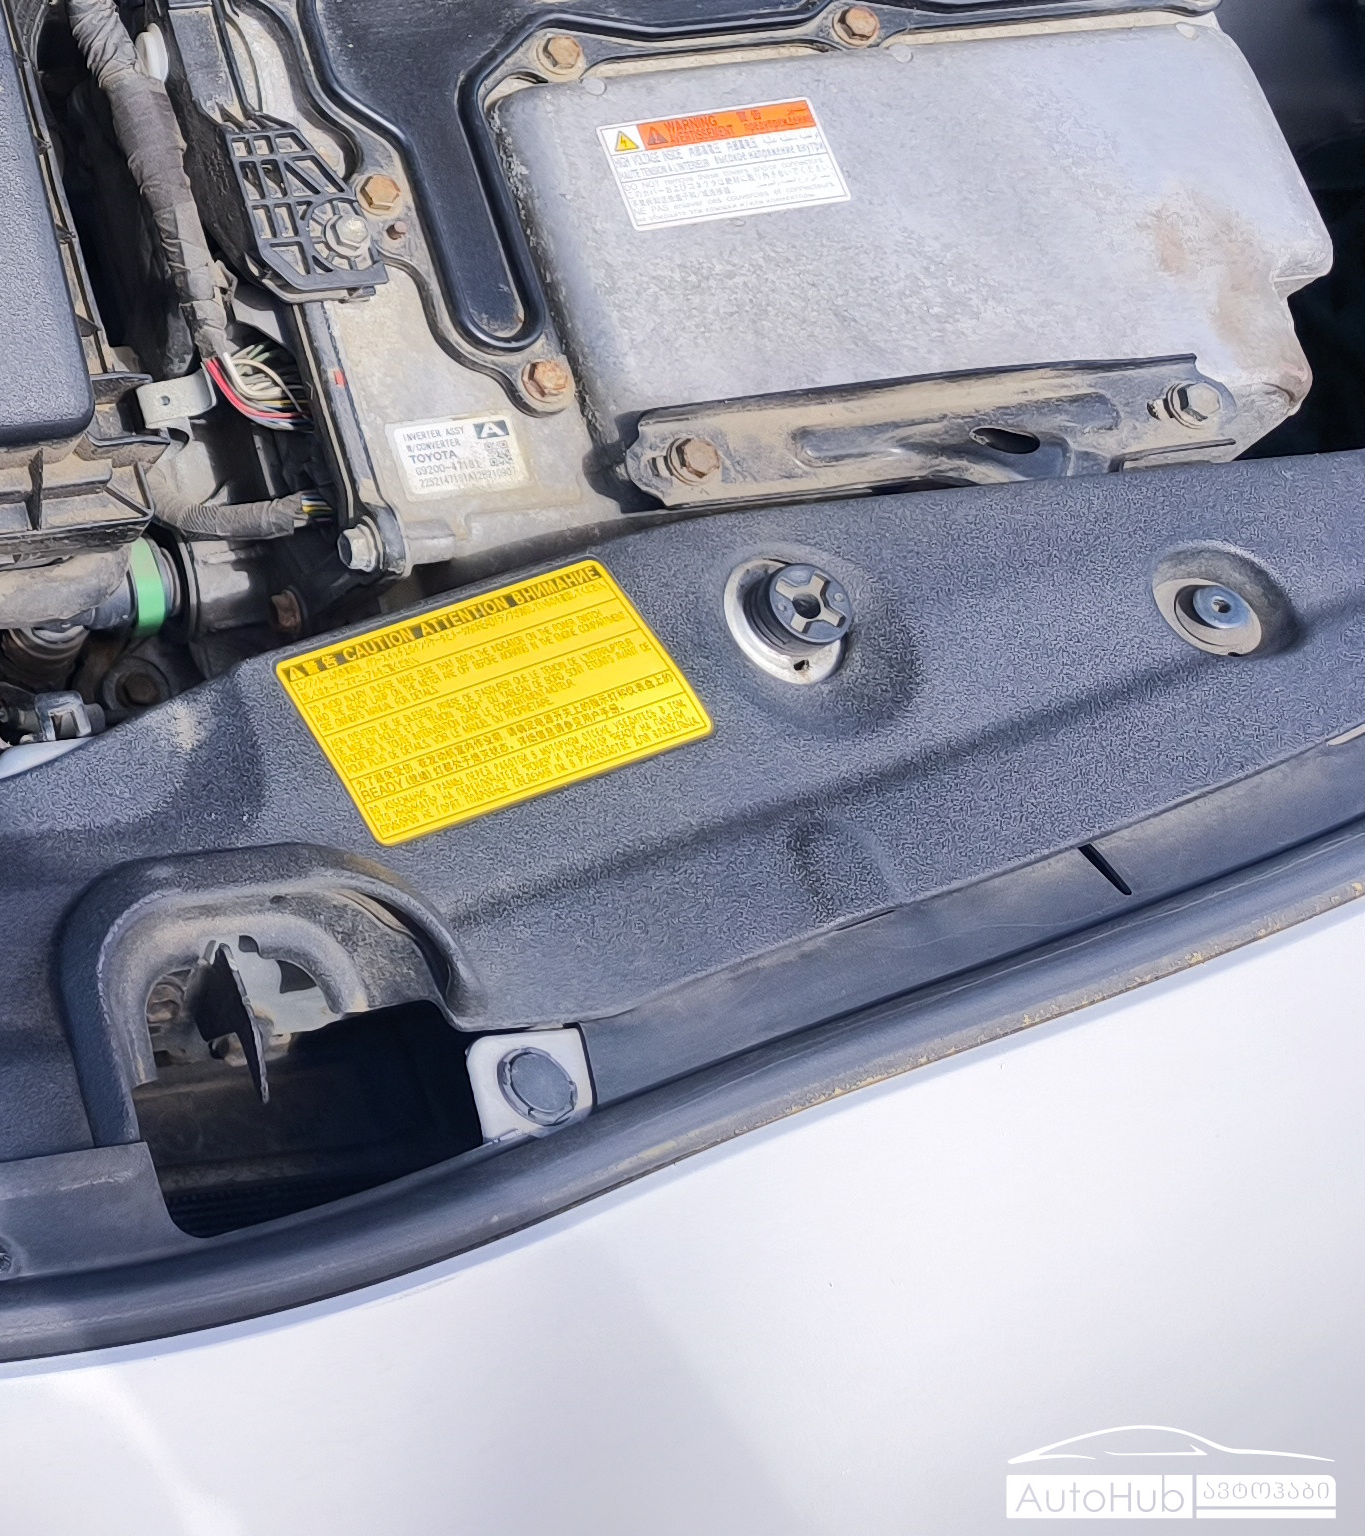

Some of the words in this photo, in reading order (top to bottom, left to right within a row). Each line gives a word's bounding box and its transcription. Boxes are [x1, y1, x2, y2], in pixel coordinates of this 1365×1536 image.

[663, 114, 718, 133] WARNING
[408, 449, 458, 465] TOYOTA
[509, 566, 601, 605] ВНИМАНИЕ
[339, 626, 416, 662] CAUTION
[415, 595, 511, 637] ATTENTION
[359, 777, 405, 802] READY
